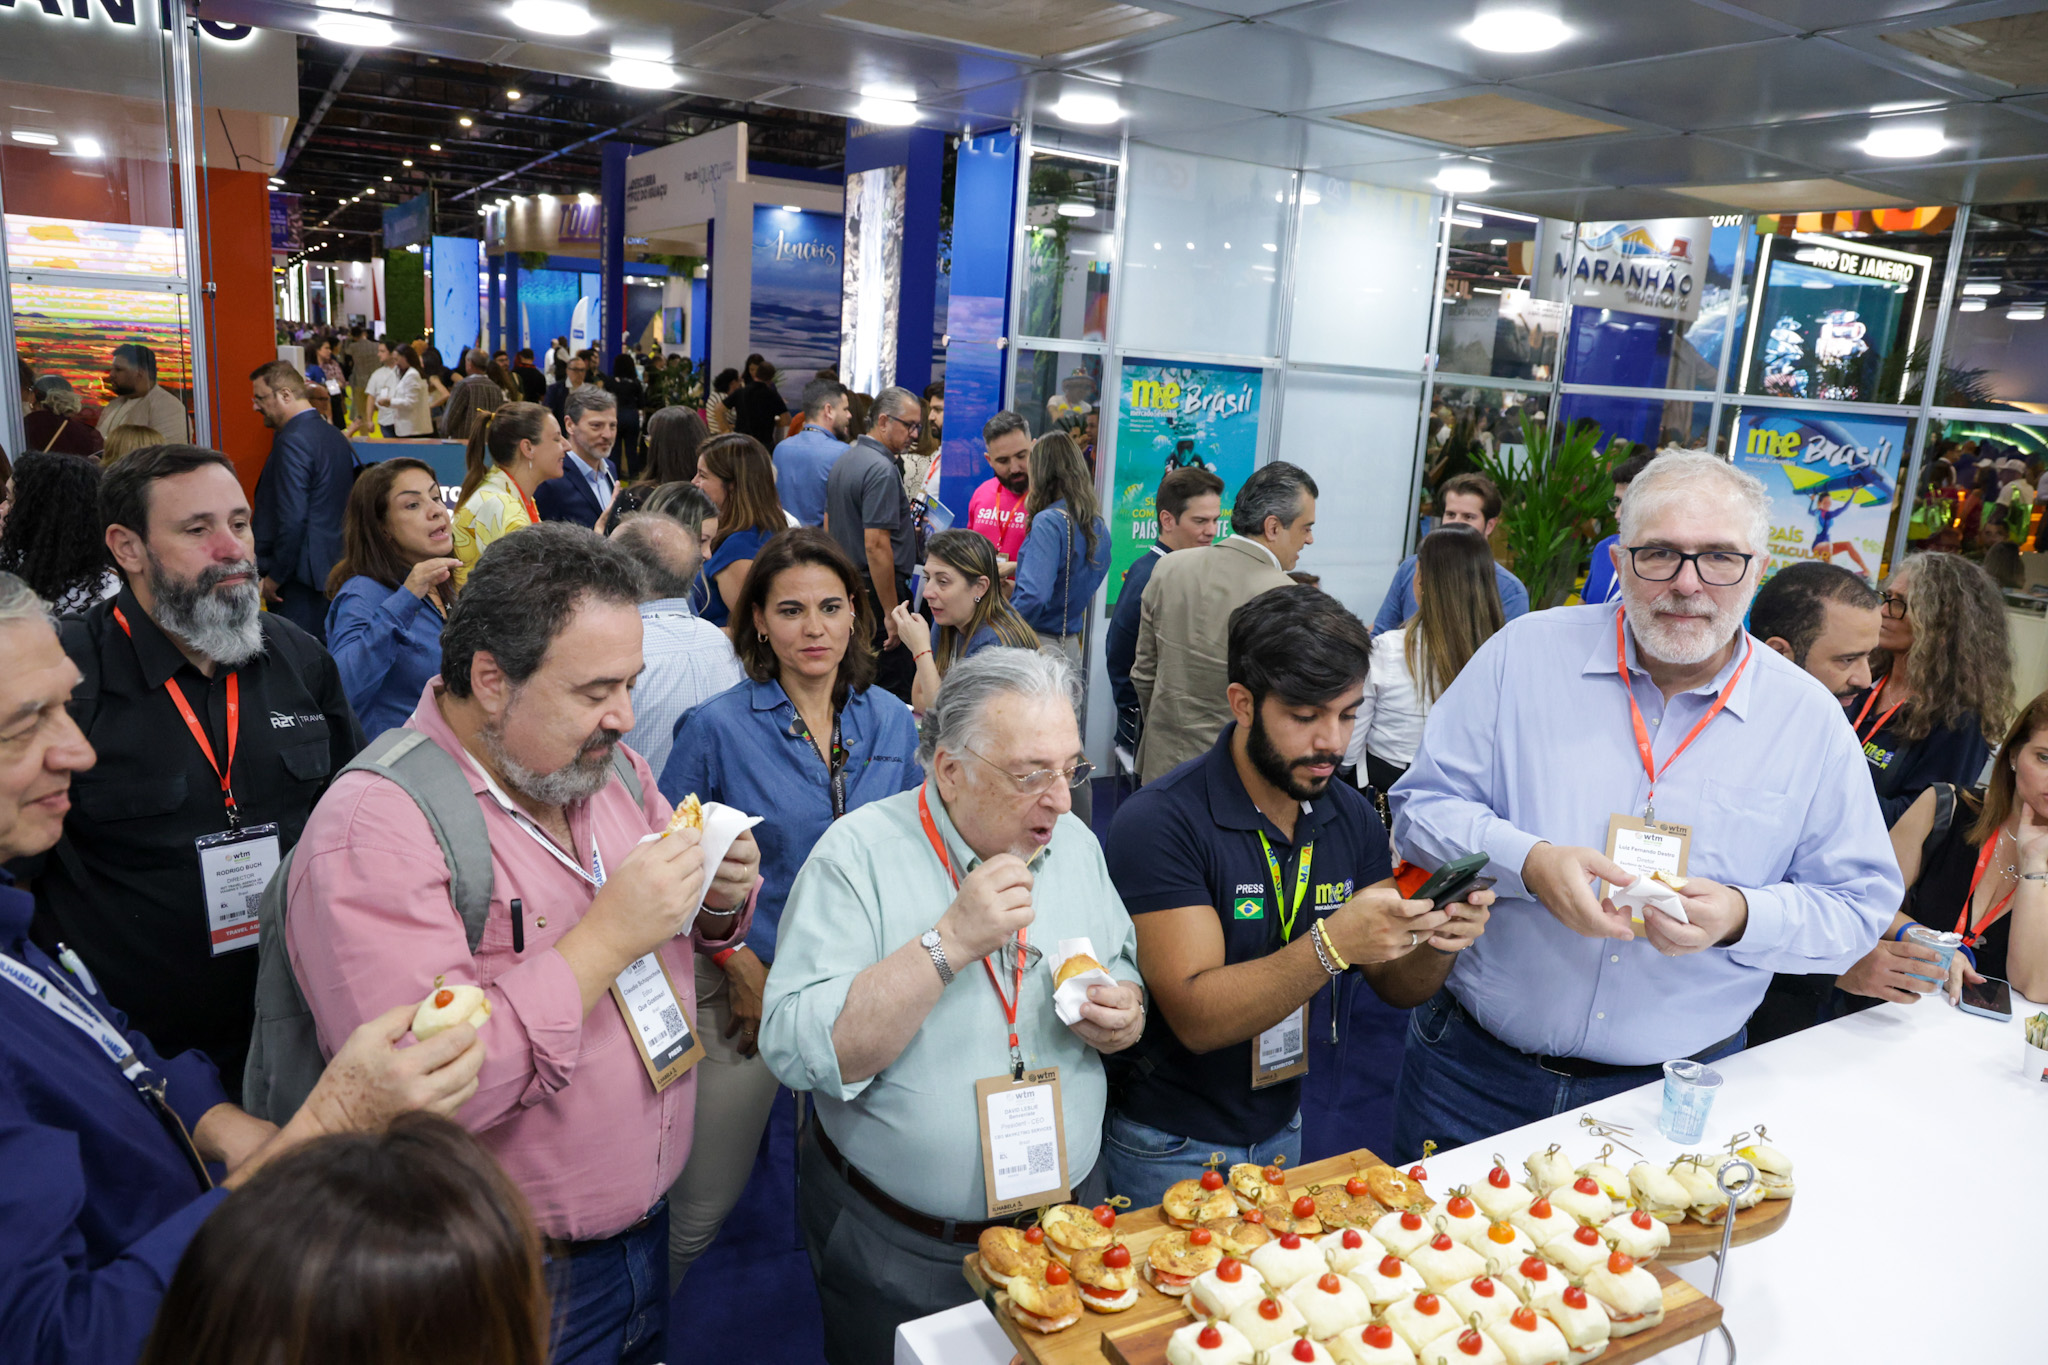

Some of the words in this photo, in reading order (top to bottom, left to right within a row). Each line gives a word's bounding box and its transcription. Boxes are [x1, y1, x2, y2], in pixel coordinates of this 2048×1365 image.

[558, 203, 601, 236] TOU
[774, 230, 836, 266] Lençóis
[1838, 252, 1858, 273] DE
[1860, 257, 1914, 283] JANEIRO
[1183, 383, 1253, 419] Brasil
[1802, 435, 1892, 471] Brasil
[1132, 509, 1155, 518] COM
[1132, 518, 1158, 540] PAÍS
[1768, 543, 1831, 561] TACULAR
[1668, 825, 1687, 834] wtm
[1643, 833, 1663, 842] wtm
[233, 851, 250, 860] wtm
[216, 865, 244, 877] RODRIGO
[245, 862, 262, 870] BUCH
[226, 872, 255, 884] DIRECTOR
[1235, 883, 1264, 894] PRESS
[225, 926, 249, 936] TRAVEL
[631, 959, 645, 971] wtm
[623, 981, 639, 996] Claudio
[637, 1003, 647, 1013] Que
[667, 1044, 683, 1060] PRESS
[1036, 1071, 1056, 1080] wtm
[1015, 1090, 1035, 1100] wtm
[1004, 1107, 1020, 1115] DAVID
[1020, 1104, 1038, 1112] LESLIE
[1031, 1116, 1045, 1125] CEO
